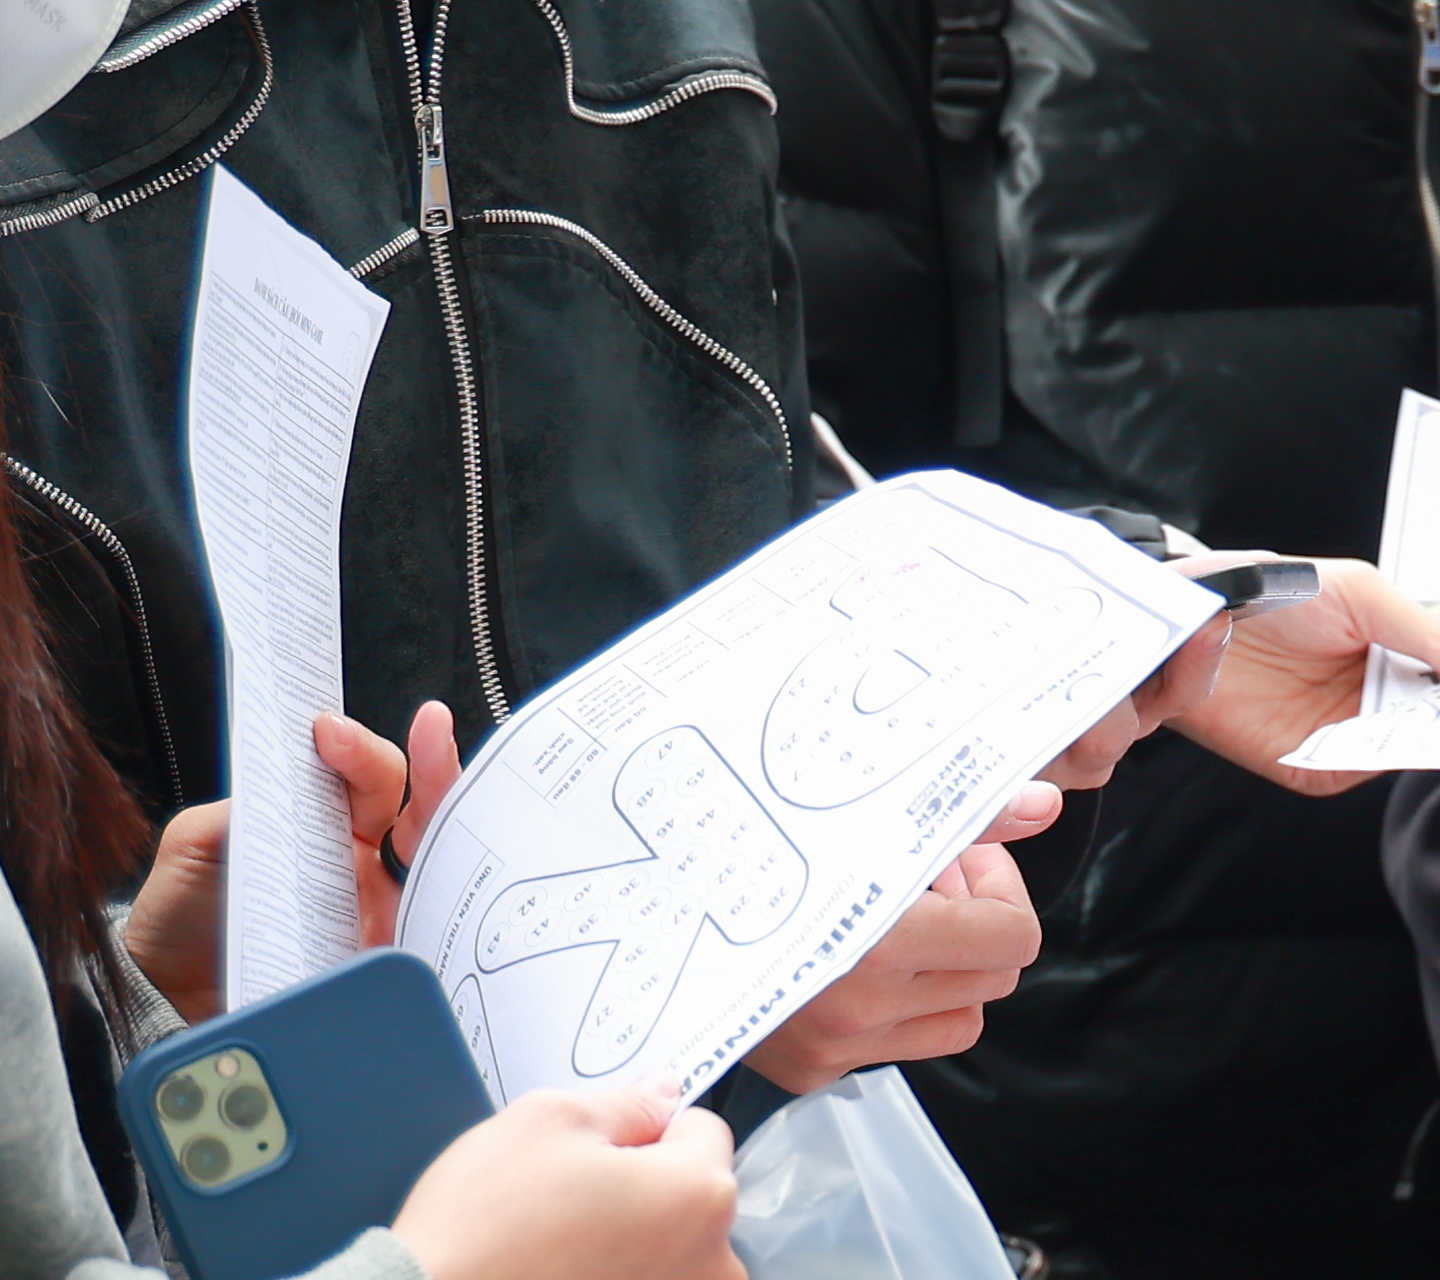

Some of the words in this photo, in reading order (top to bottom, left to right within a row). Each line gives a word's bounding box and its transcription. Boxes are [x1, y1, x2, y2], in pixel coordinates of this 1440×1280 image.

[658, 740, 673, 760] 47
[686, 768, 705, 786] 45
[636, 788, 654, 808] 48
[656, 819, 674, 837] 46
[696, 809, 715, 828] 44
[731, 823, 747, 841] 33
[677, 852, 698, 873] 34
[759, 854, 775, 872] 31
[718, 865, 734, 885] 32
[573, 884, 592, 902] 40
[618, 878, 640, 897] 36
[768, 886, 787, 908] 28
[518, 896, 536, 916] 42
[639, 898, 662, 917] 38
[730, 895, 746, 916] 29
[578, 914, 598, 934] 39
[674, 906, 690, 925] 37
[532, 918, 549, 937] 41
[793, 883, 881, 980] PHIẾU
[487, 932, 500, 954] 43
[625, 944, 648, 962] 35
[640, 973, 663, 992] 30
[596, 1005, 612, 1027] 27
[617, 1023, 635, 1044] 26
